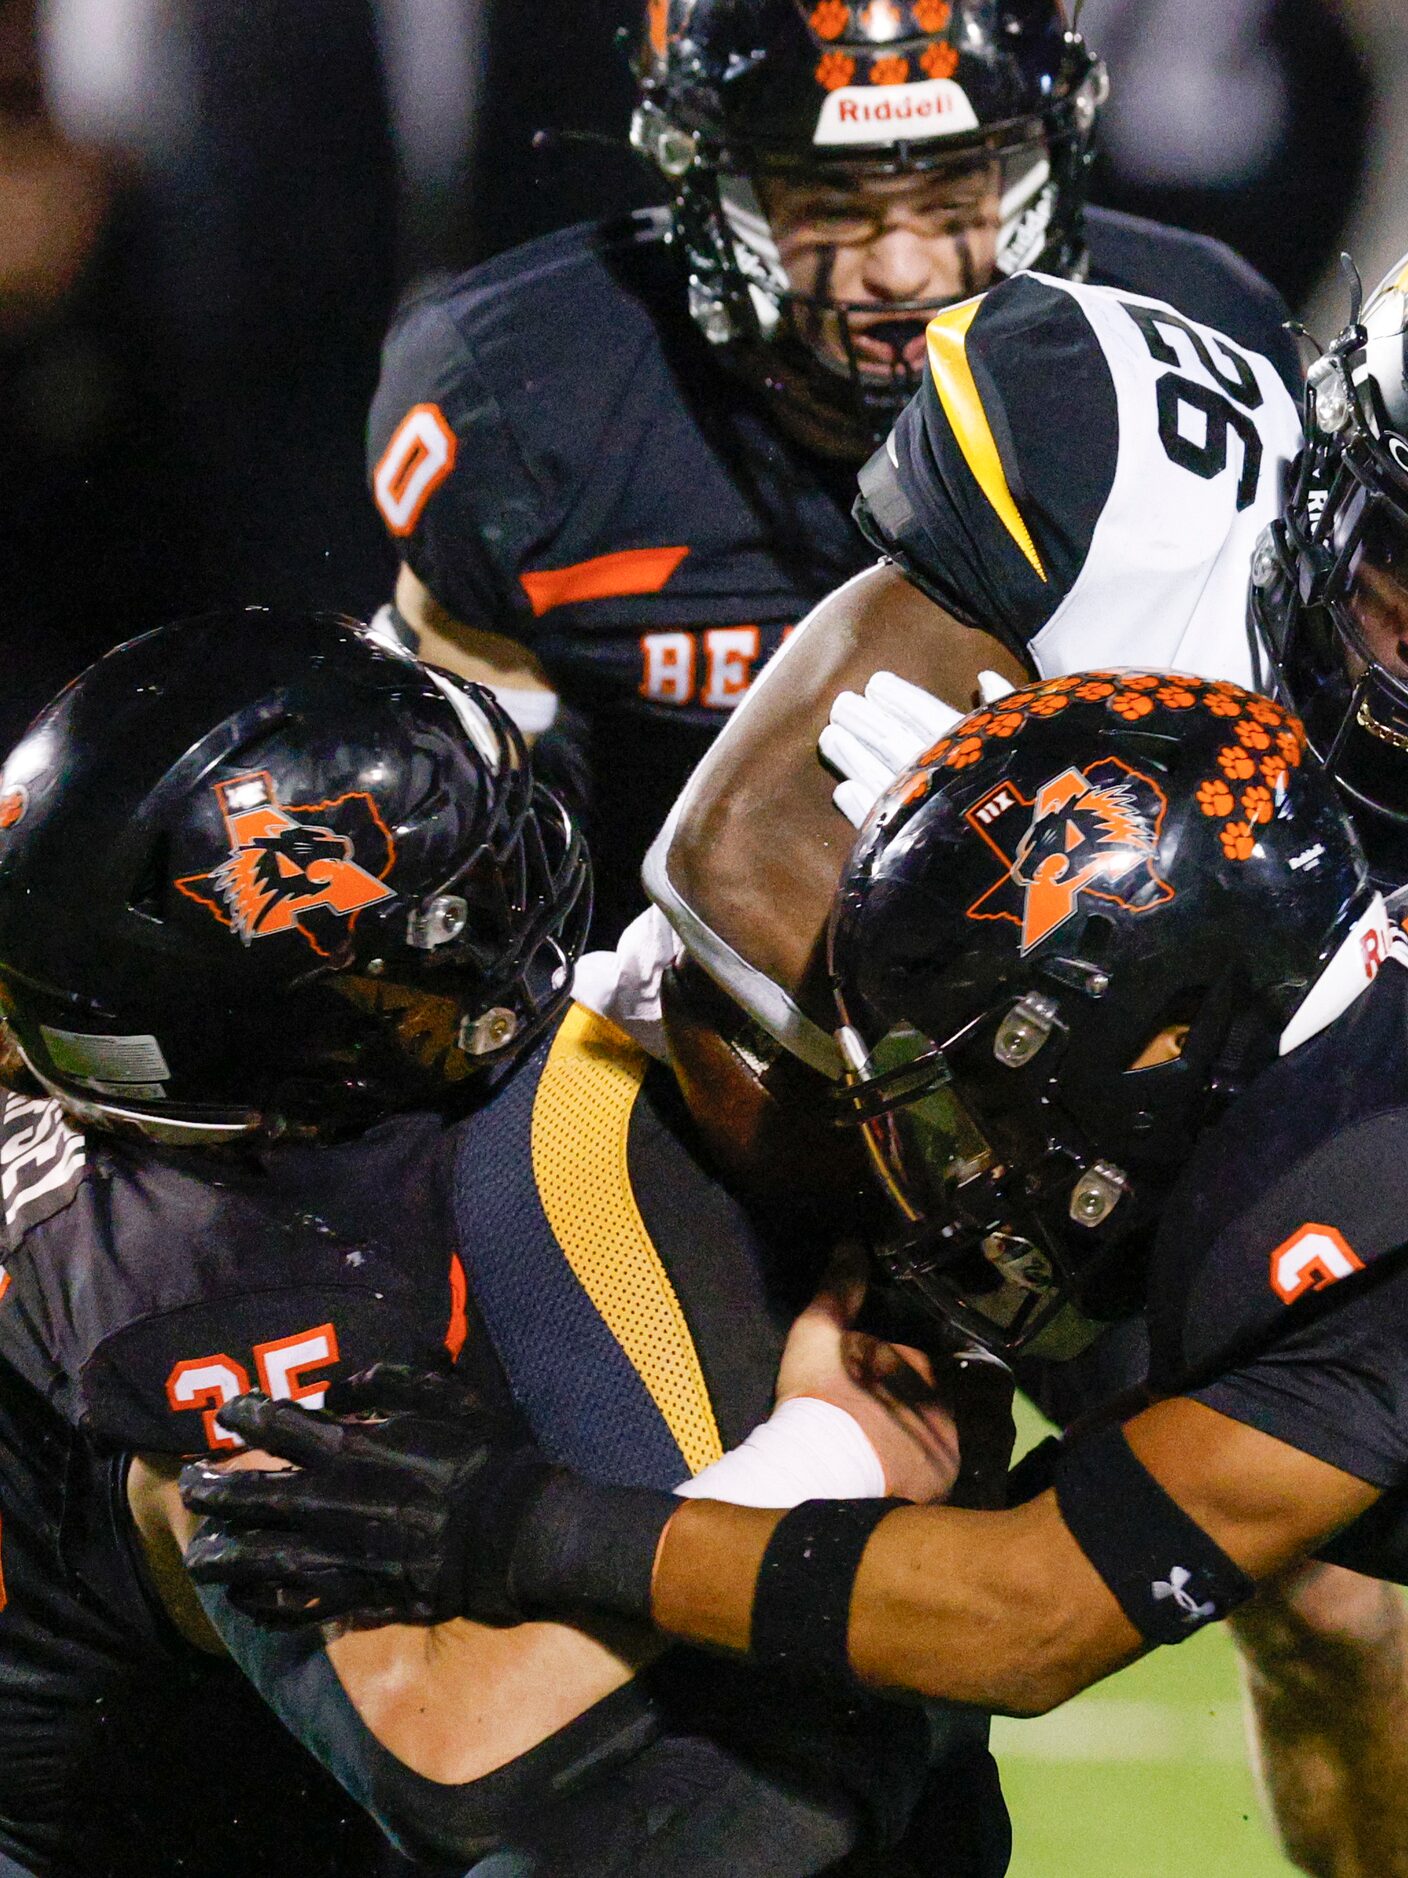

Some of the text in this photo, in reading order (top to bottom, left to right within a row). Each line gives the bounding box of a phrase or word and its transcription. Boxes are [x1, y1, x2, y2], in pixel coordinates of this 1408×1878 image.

[838, 92, 953, 122] Riddell
[1116, 300, 1264, 512] 26
[374, 403, 457, 537] 0
[640, 626, 805, 709] BE
